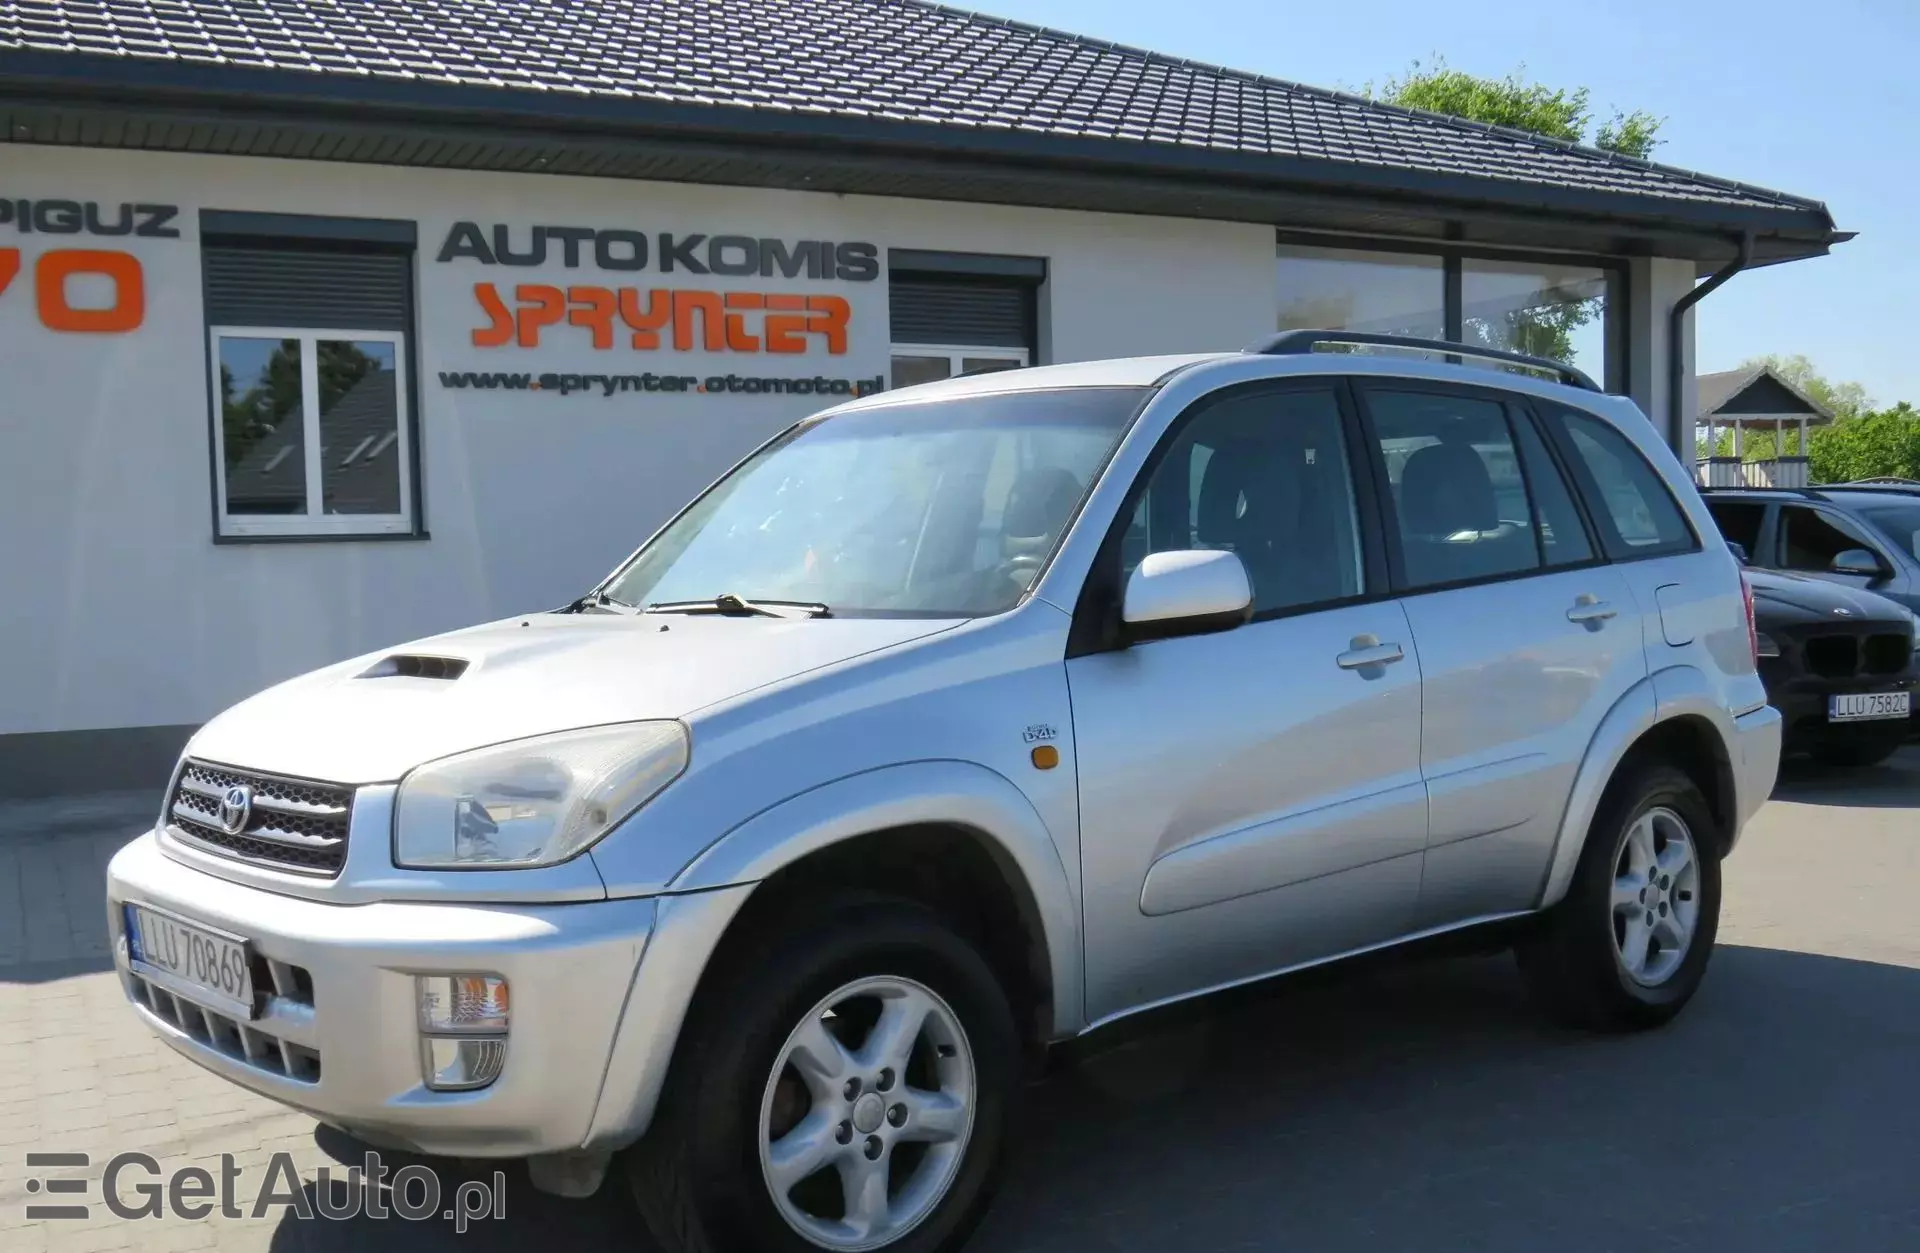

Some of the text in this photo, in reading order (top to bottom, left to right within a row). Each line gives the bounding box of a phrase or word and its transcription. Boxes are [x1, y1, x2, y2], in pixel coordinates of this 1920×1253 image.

[436, 221, 879, 281] AUTO KOMIS
[0, 247, 145, 333] 0
[471, 282, 851, 354] SPRYNTER
[438, 370, 884, 396] www.sprynter.otomoto.pl
